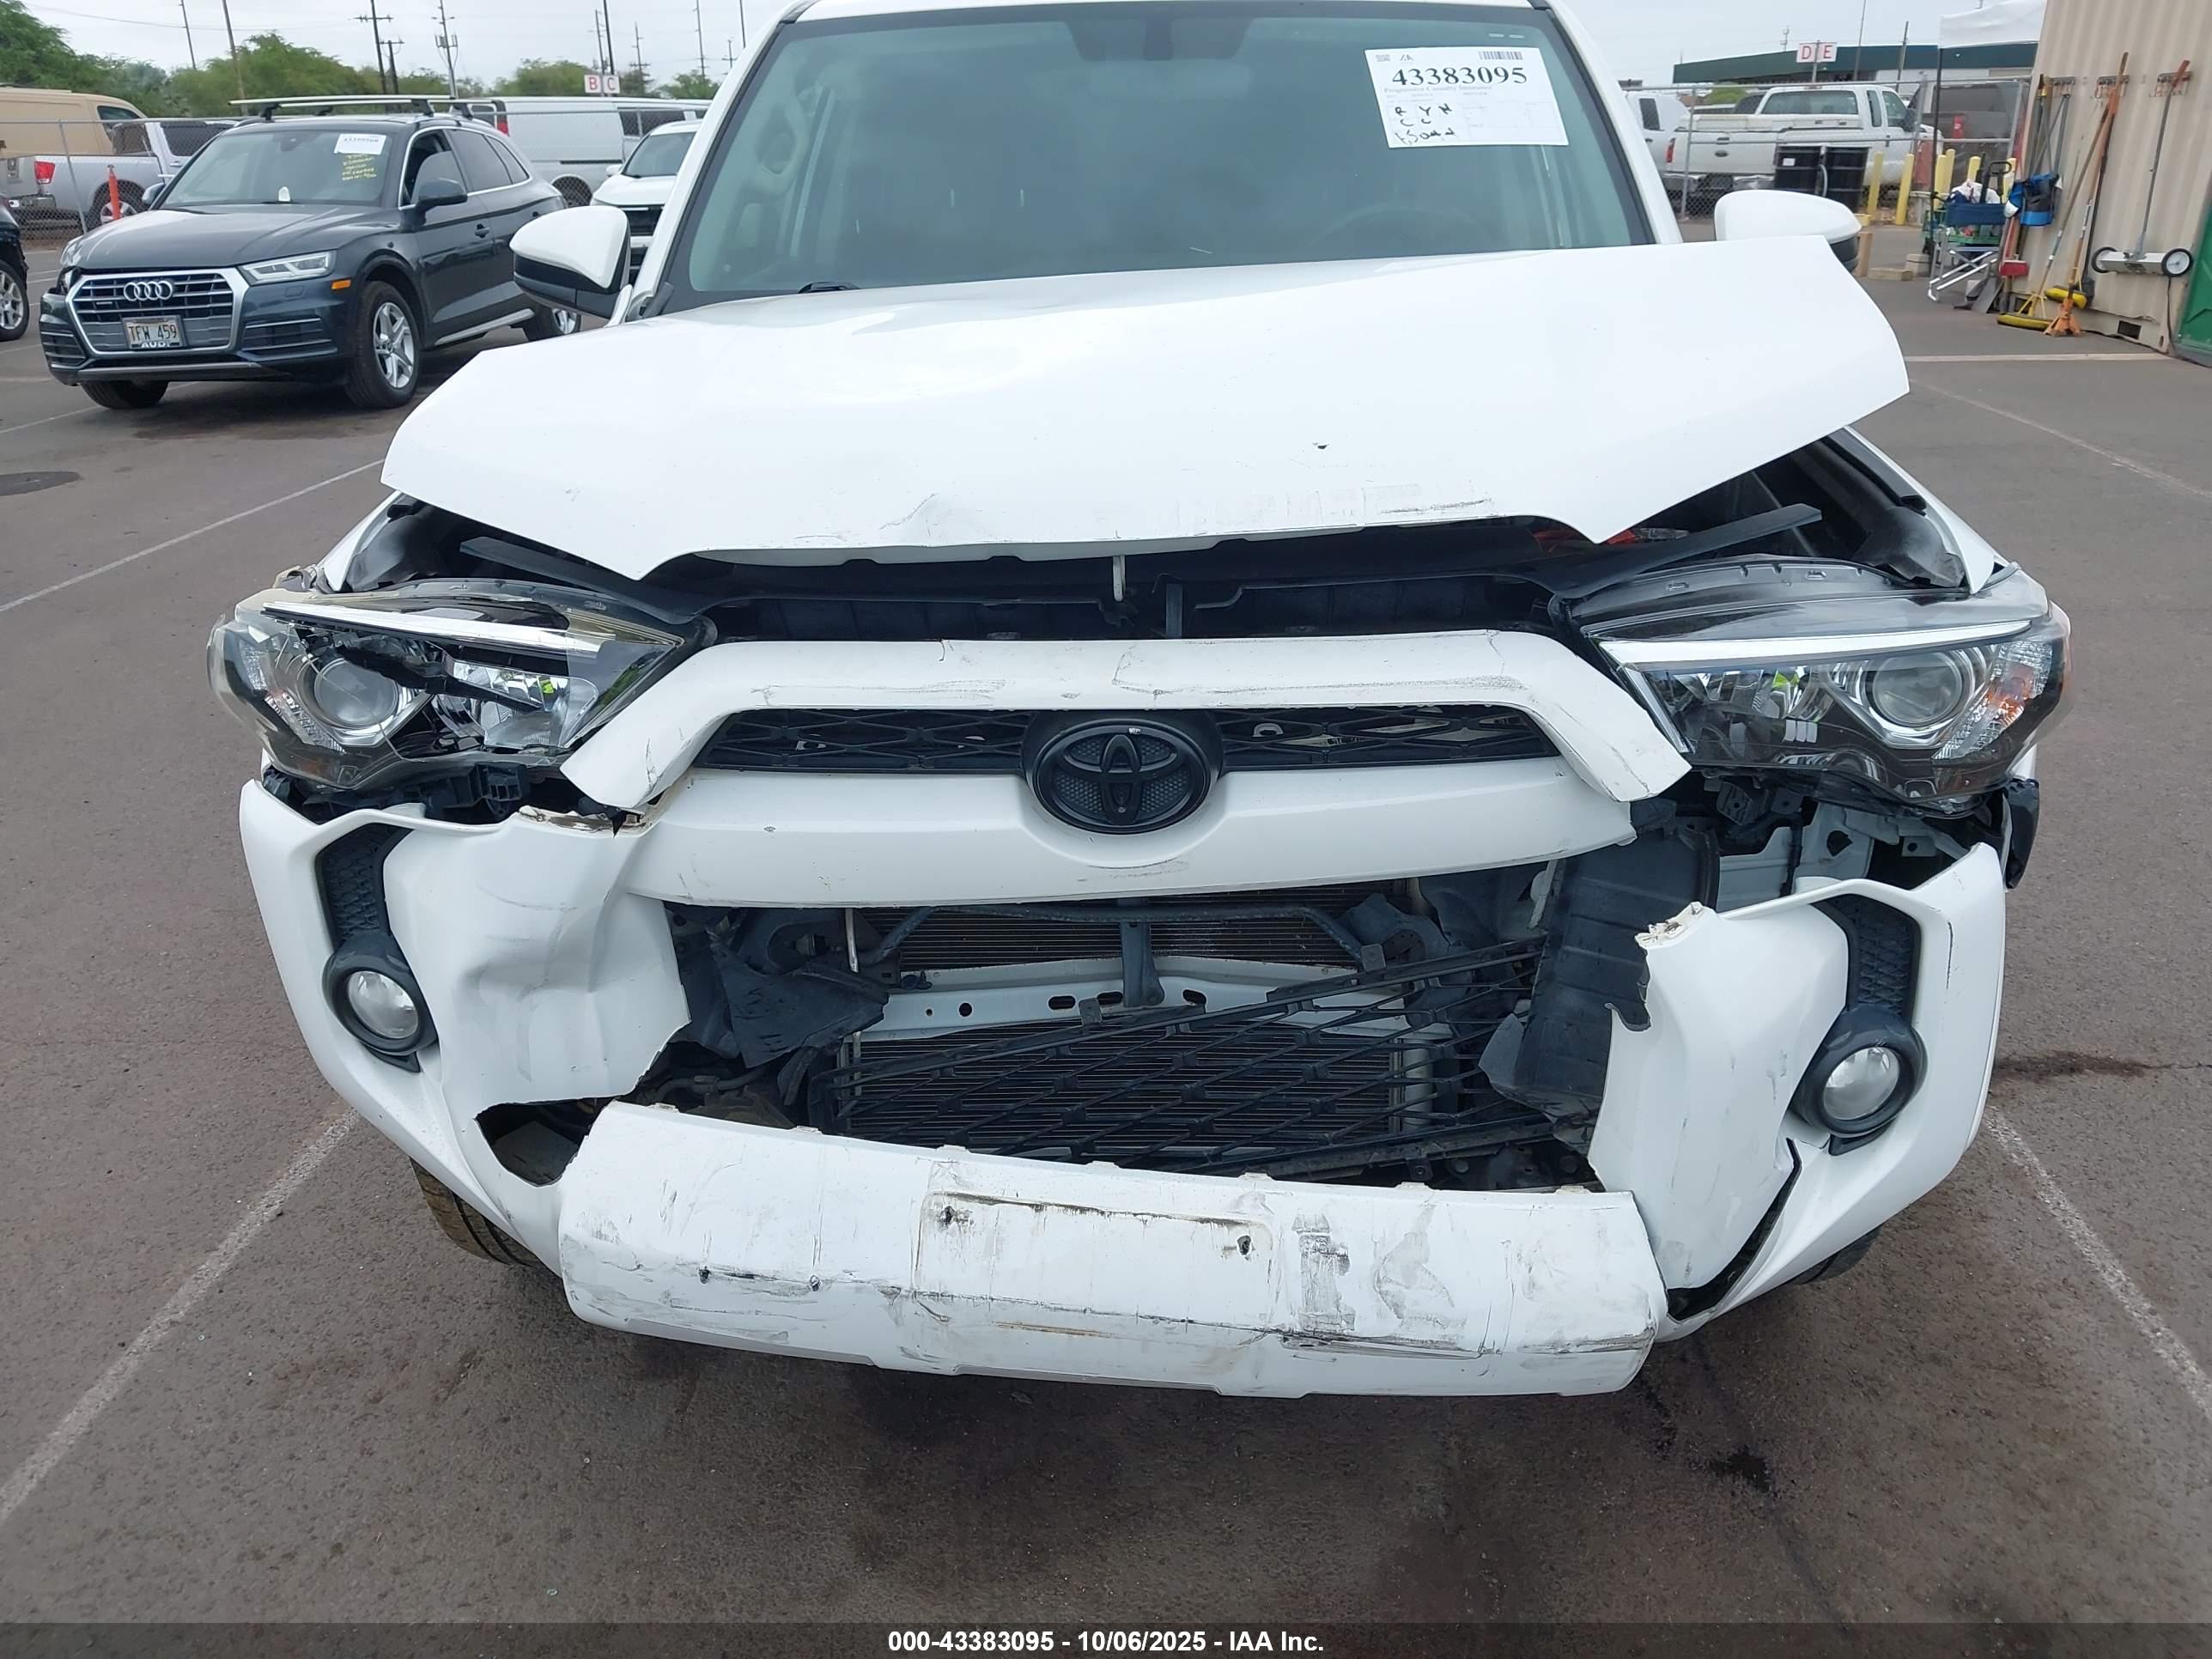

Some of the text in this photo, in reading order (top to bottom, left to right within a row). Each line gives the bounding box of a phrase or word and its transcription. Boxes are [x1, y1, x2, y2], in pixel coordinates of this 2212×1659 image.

[1802, 45, 1833, 59] D E
[589, 76, 616, 90] B C
[1392, 66, 1528, 86] 43383095
[128, 324, 177, 341] TFW 459
